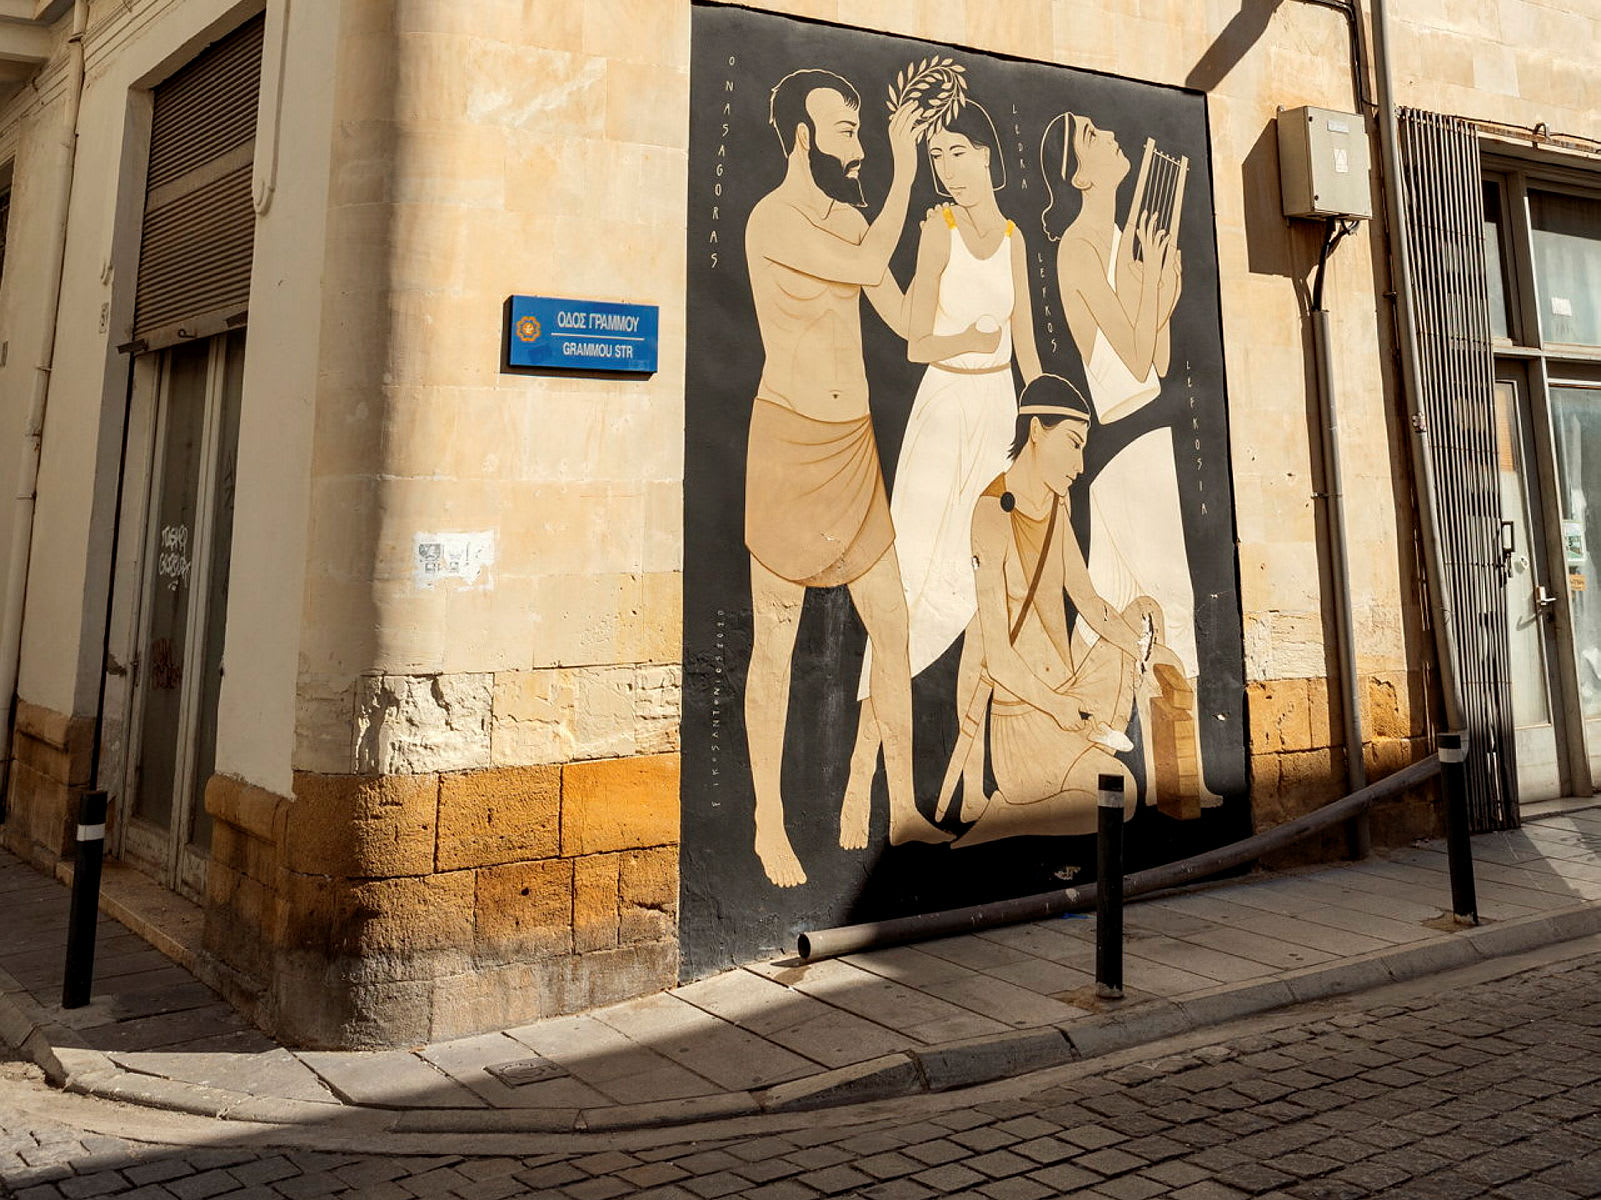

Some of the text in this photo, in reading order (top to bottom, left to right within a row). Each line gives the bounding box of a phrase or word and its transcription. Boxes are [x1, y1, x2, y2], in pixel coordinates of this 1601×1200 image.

[709, 55, 736, 269] ONASAGORAS
[1012, 103, 1028, 190] LEDRA
[557, 311, 639, 332] ΟΔΟΣ ΓΡΑΜΜΟΥ
[563, 342, 633, 359] GRAMMOU STR
